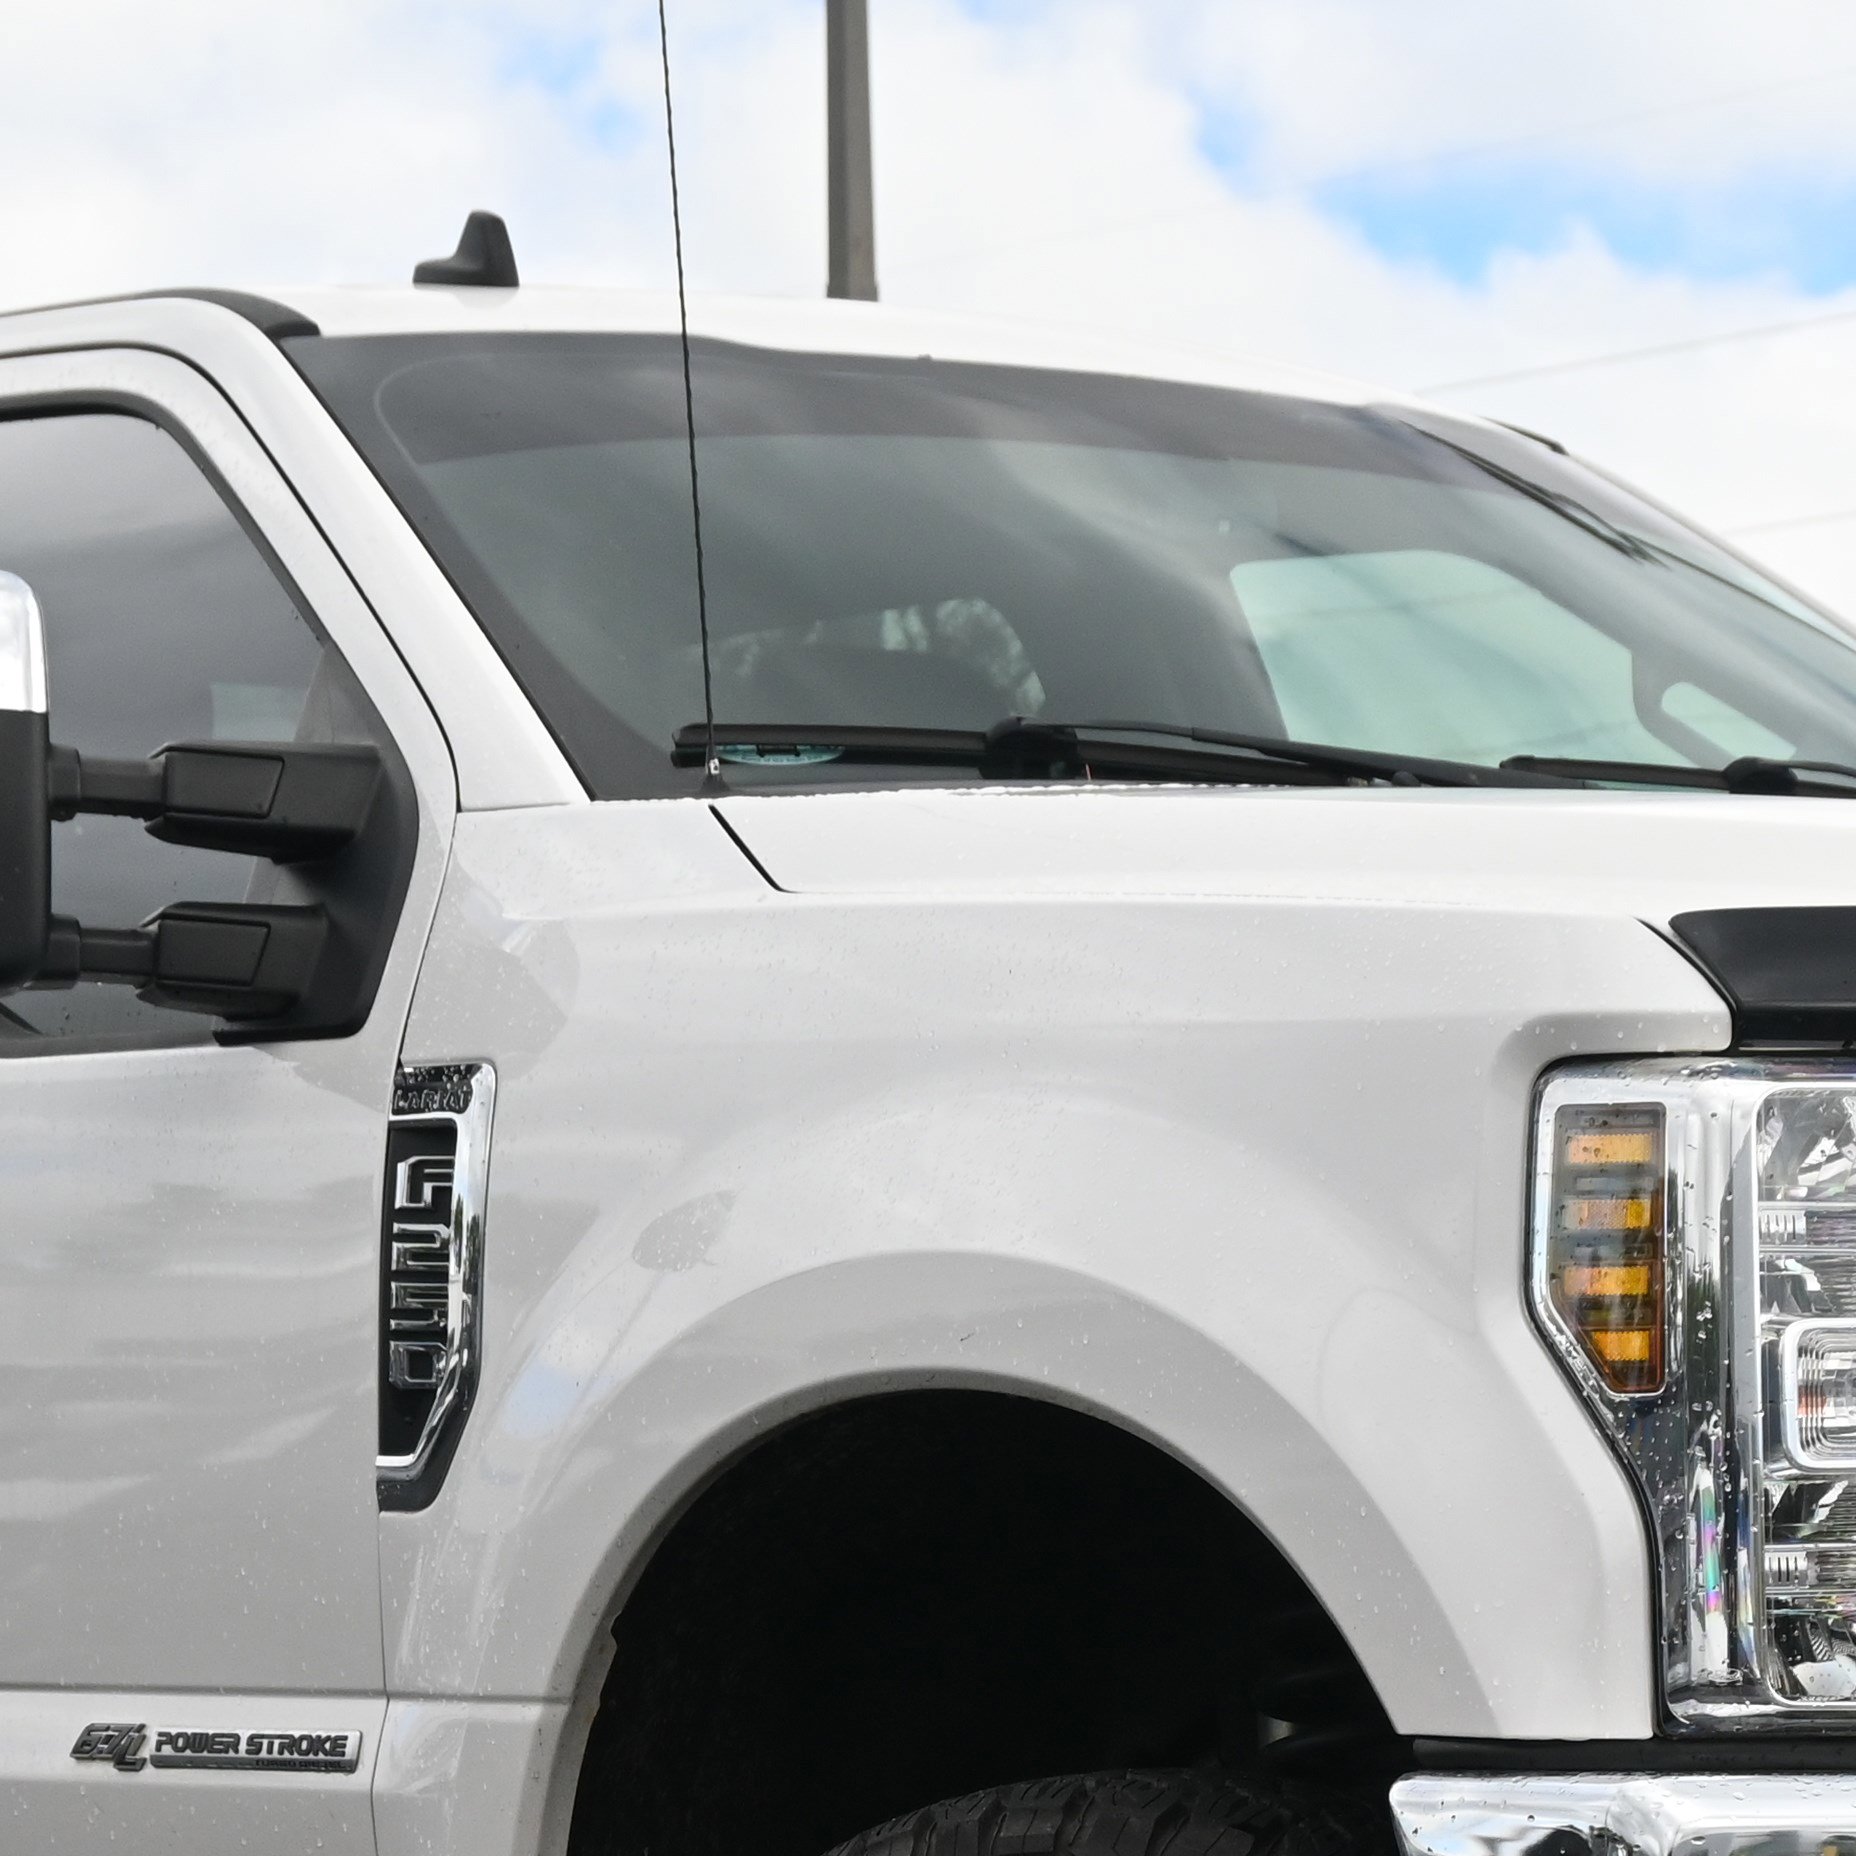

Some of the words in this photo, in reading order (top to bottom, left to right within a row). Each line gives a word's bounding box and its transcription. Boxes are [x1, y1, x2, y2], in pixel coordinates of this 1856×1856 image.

[393, 1087, 472, 1111] LARIAT
[154, 1731, 241, 1754] POWER
[244, 1733, 349, 1758] STROKE
